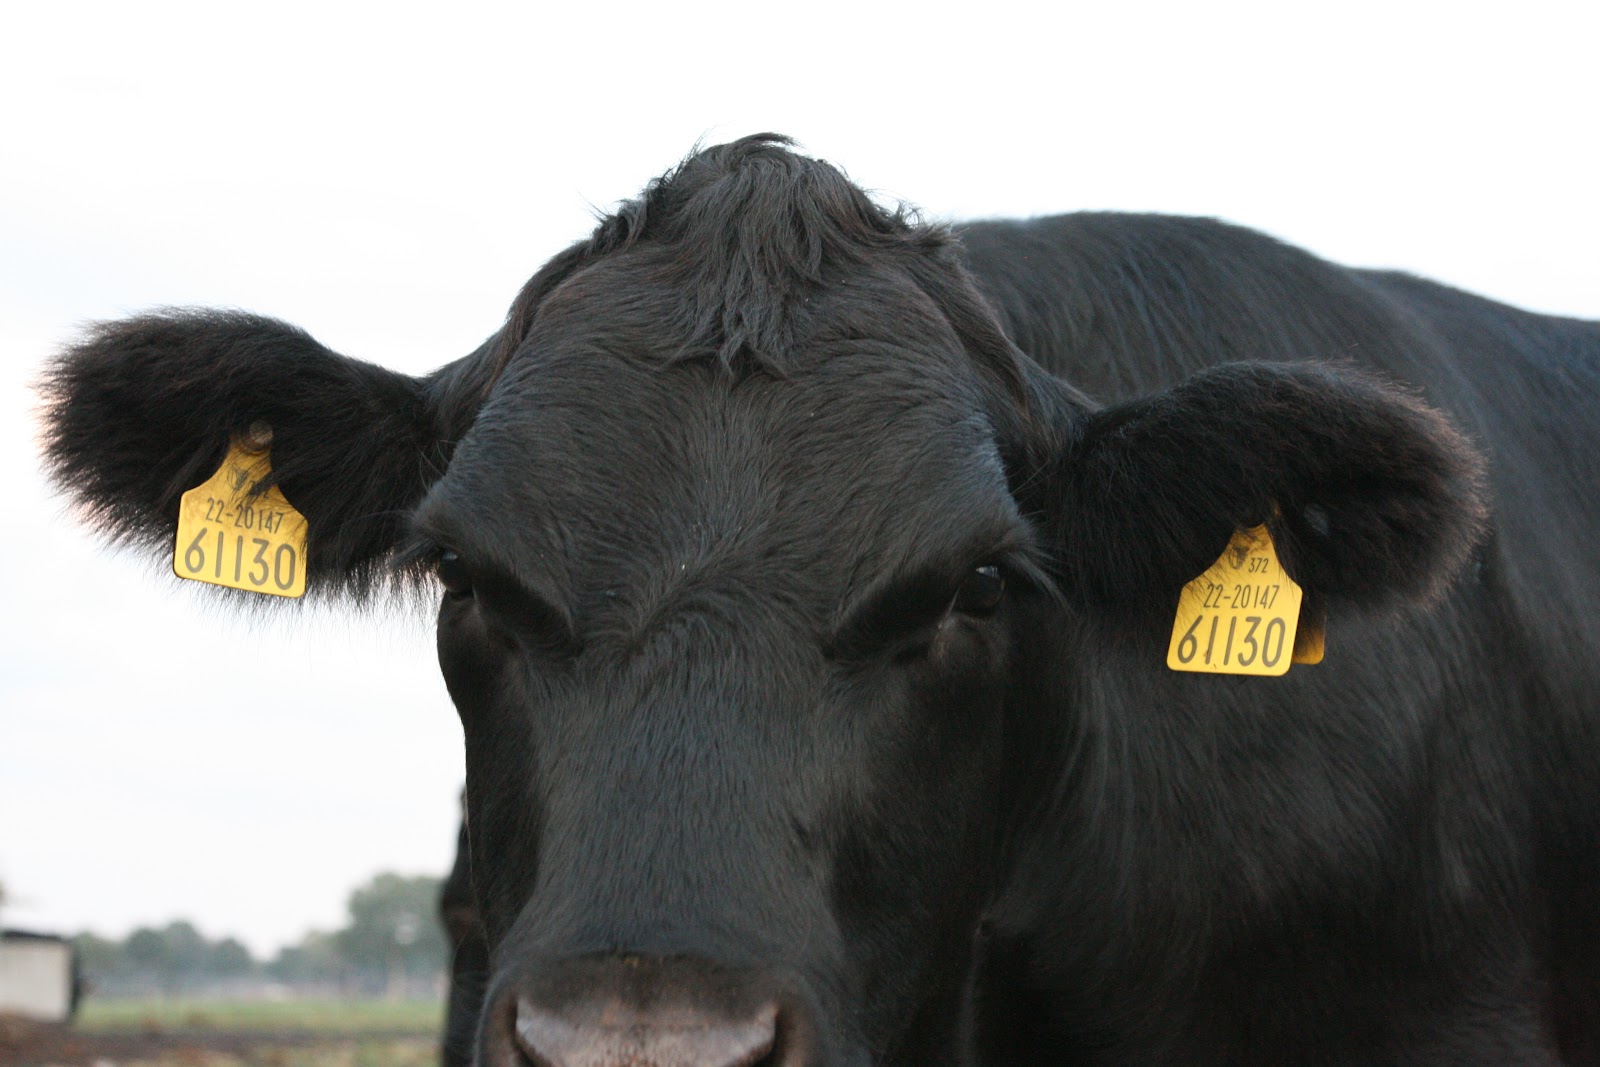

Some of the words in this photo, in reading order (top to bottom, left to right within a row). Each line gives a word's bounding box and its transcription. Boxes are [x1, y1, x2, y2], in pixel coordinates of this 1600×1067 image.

[205, 497, 284, 534] 22-20147
[184, 527, 296, 591] 61130
[1248, 557, 1270, 574] 372
[1203, 583, 1281, 610] 22-20147
[1177, 614, 1287, 668] 61130
